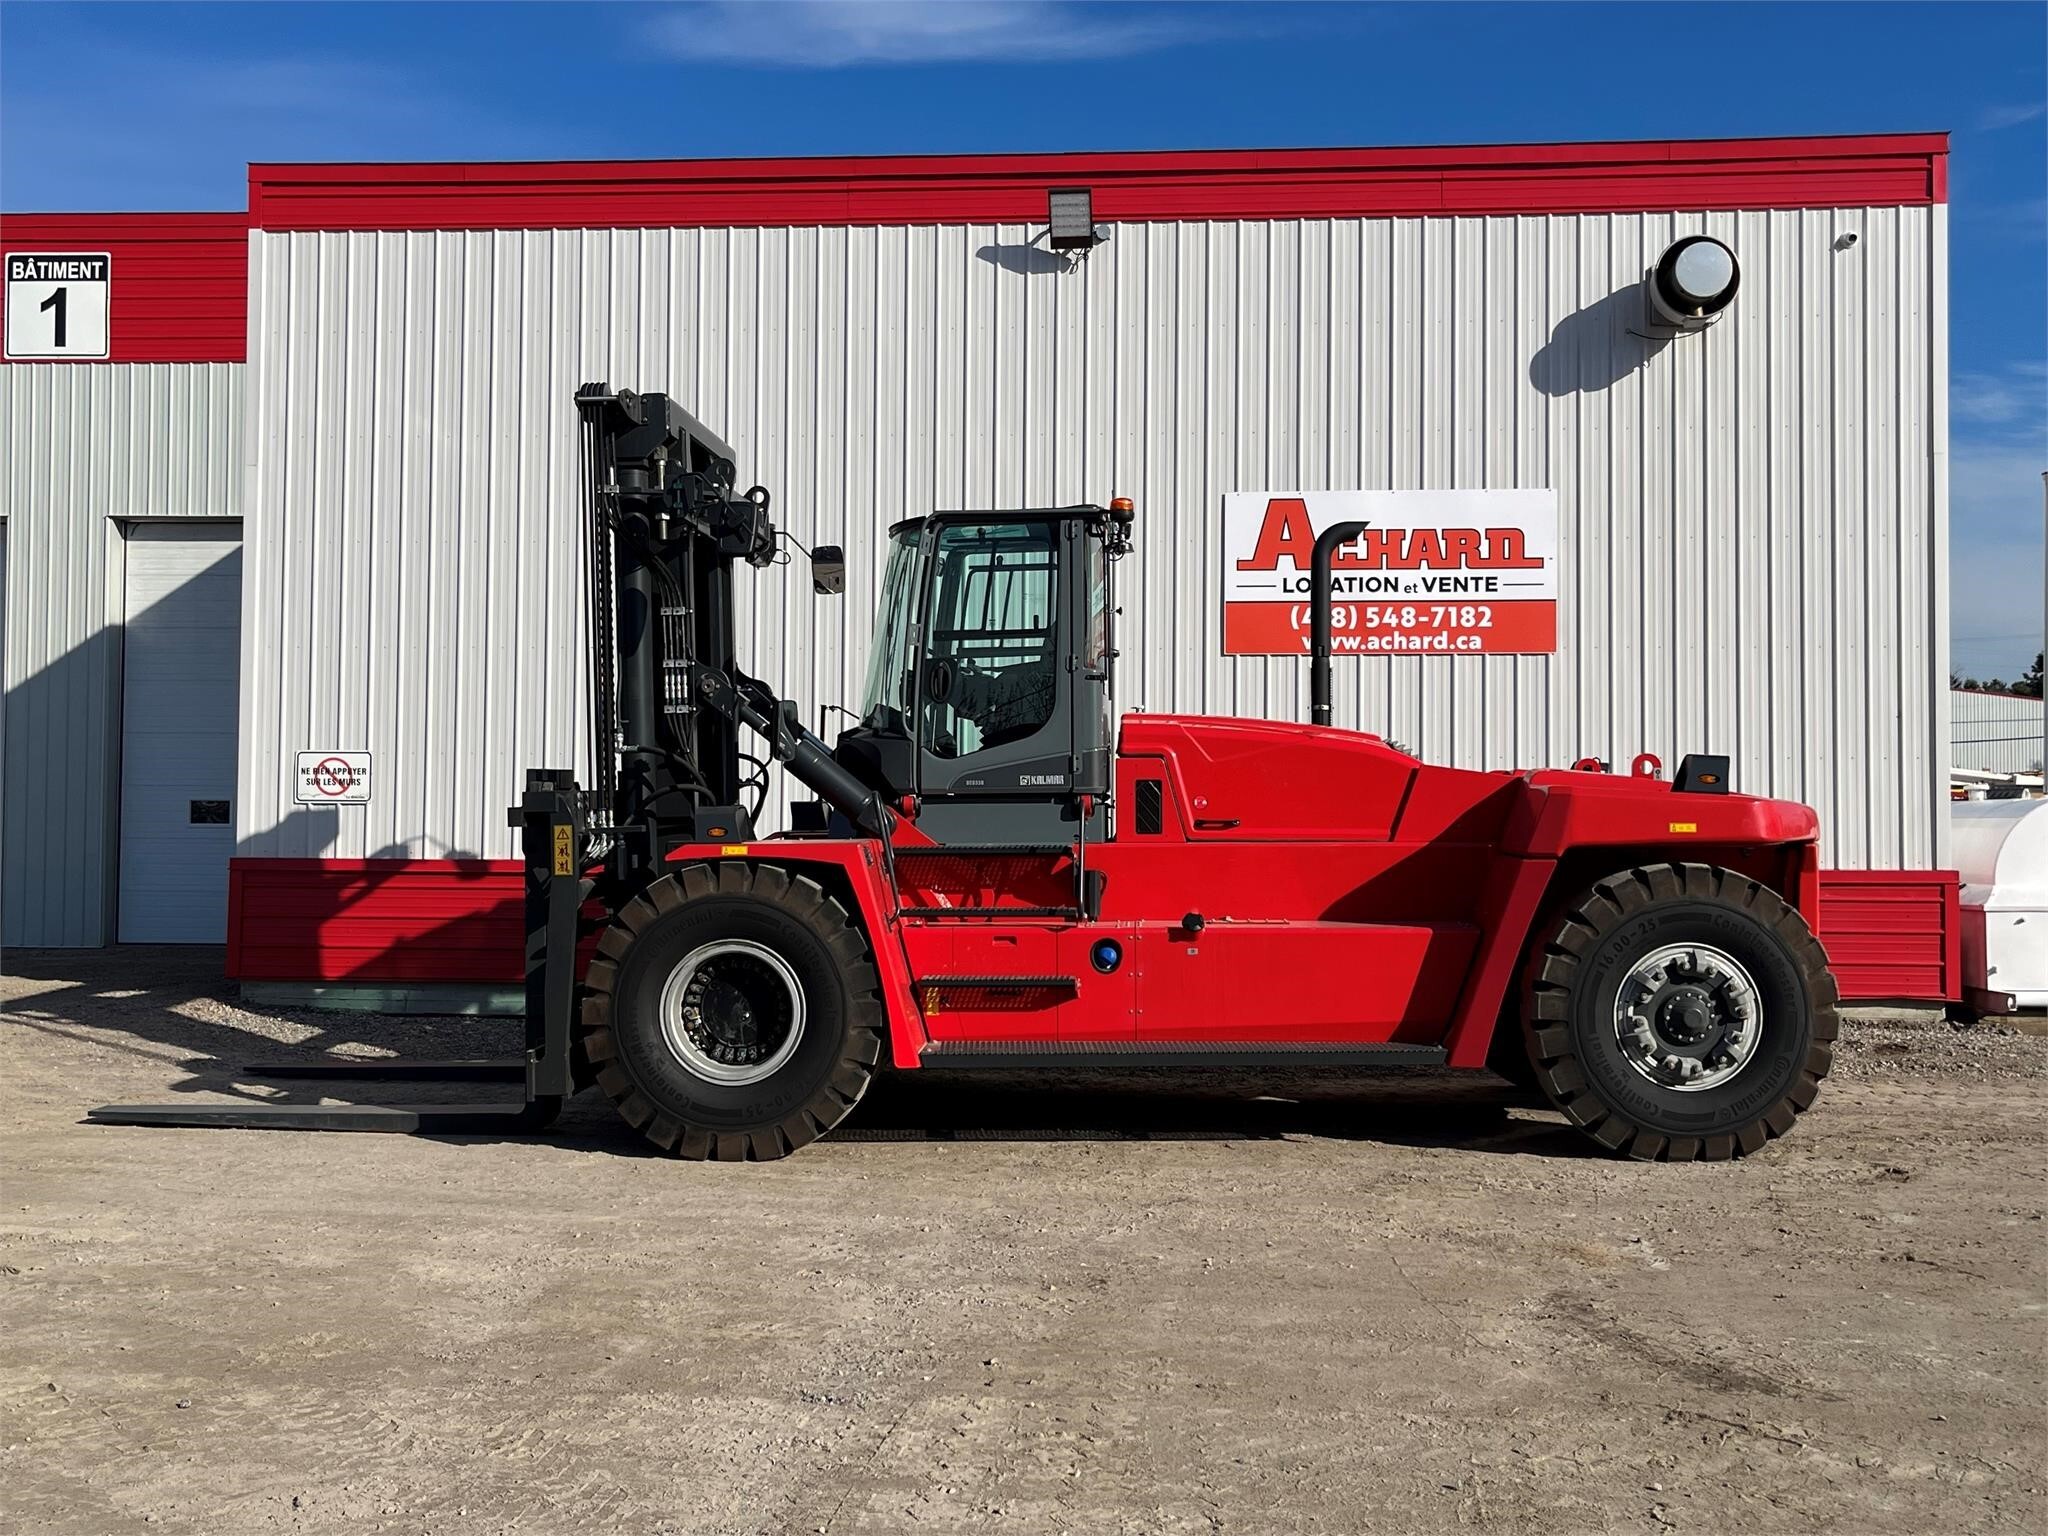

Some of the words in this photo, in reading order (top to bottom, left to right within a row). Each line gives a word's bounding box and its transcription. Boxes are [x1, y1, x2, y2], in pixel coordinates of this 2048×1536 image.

[12, 258, 103, 279] BÂTIMENT
[40, 287, 67, 347] 1
[1282, 576, 1399, 593] LOATION
[1404, 581, 1418, 594] et
[1421, 576, 1498, 593] VENTE
[1291, 605, 1357, 630] (48)
[1366, 606, 1493, 628] 548-7182
[301, 767, 310, 775] NE
[313, 767, 331, 775] RIEN
[333, 767, 367, 776] APPUYER
[1031, 775, 1064, 785] KALMAR
[306, 778, 321, 786] SUR
[323, 778, 337, 786] LES
[339, 778, 361, 786] MURS
[1599, 917, 1656, 969] 16.00-25
